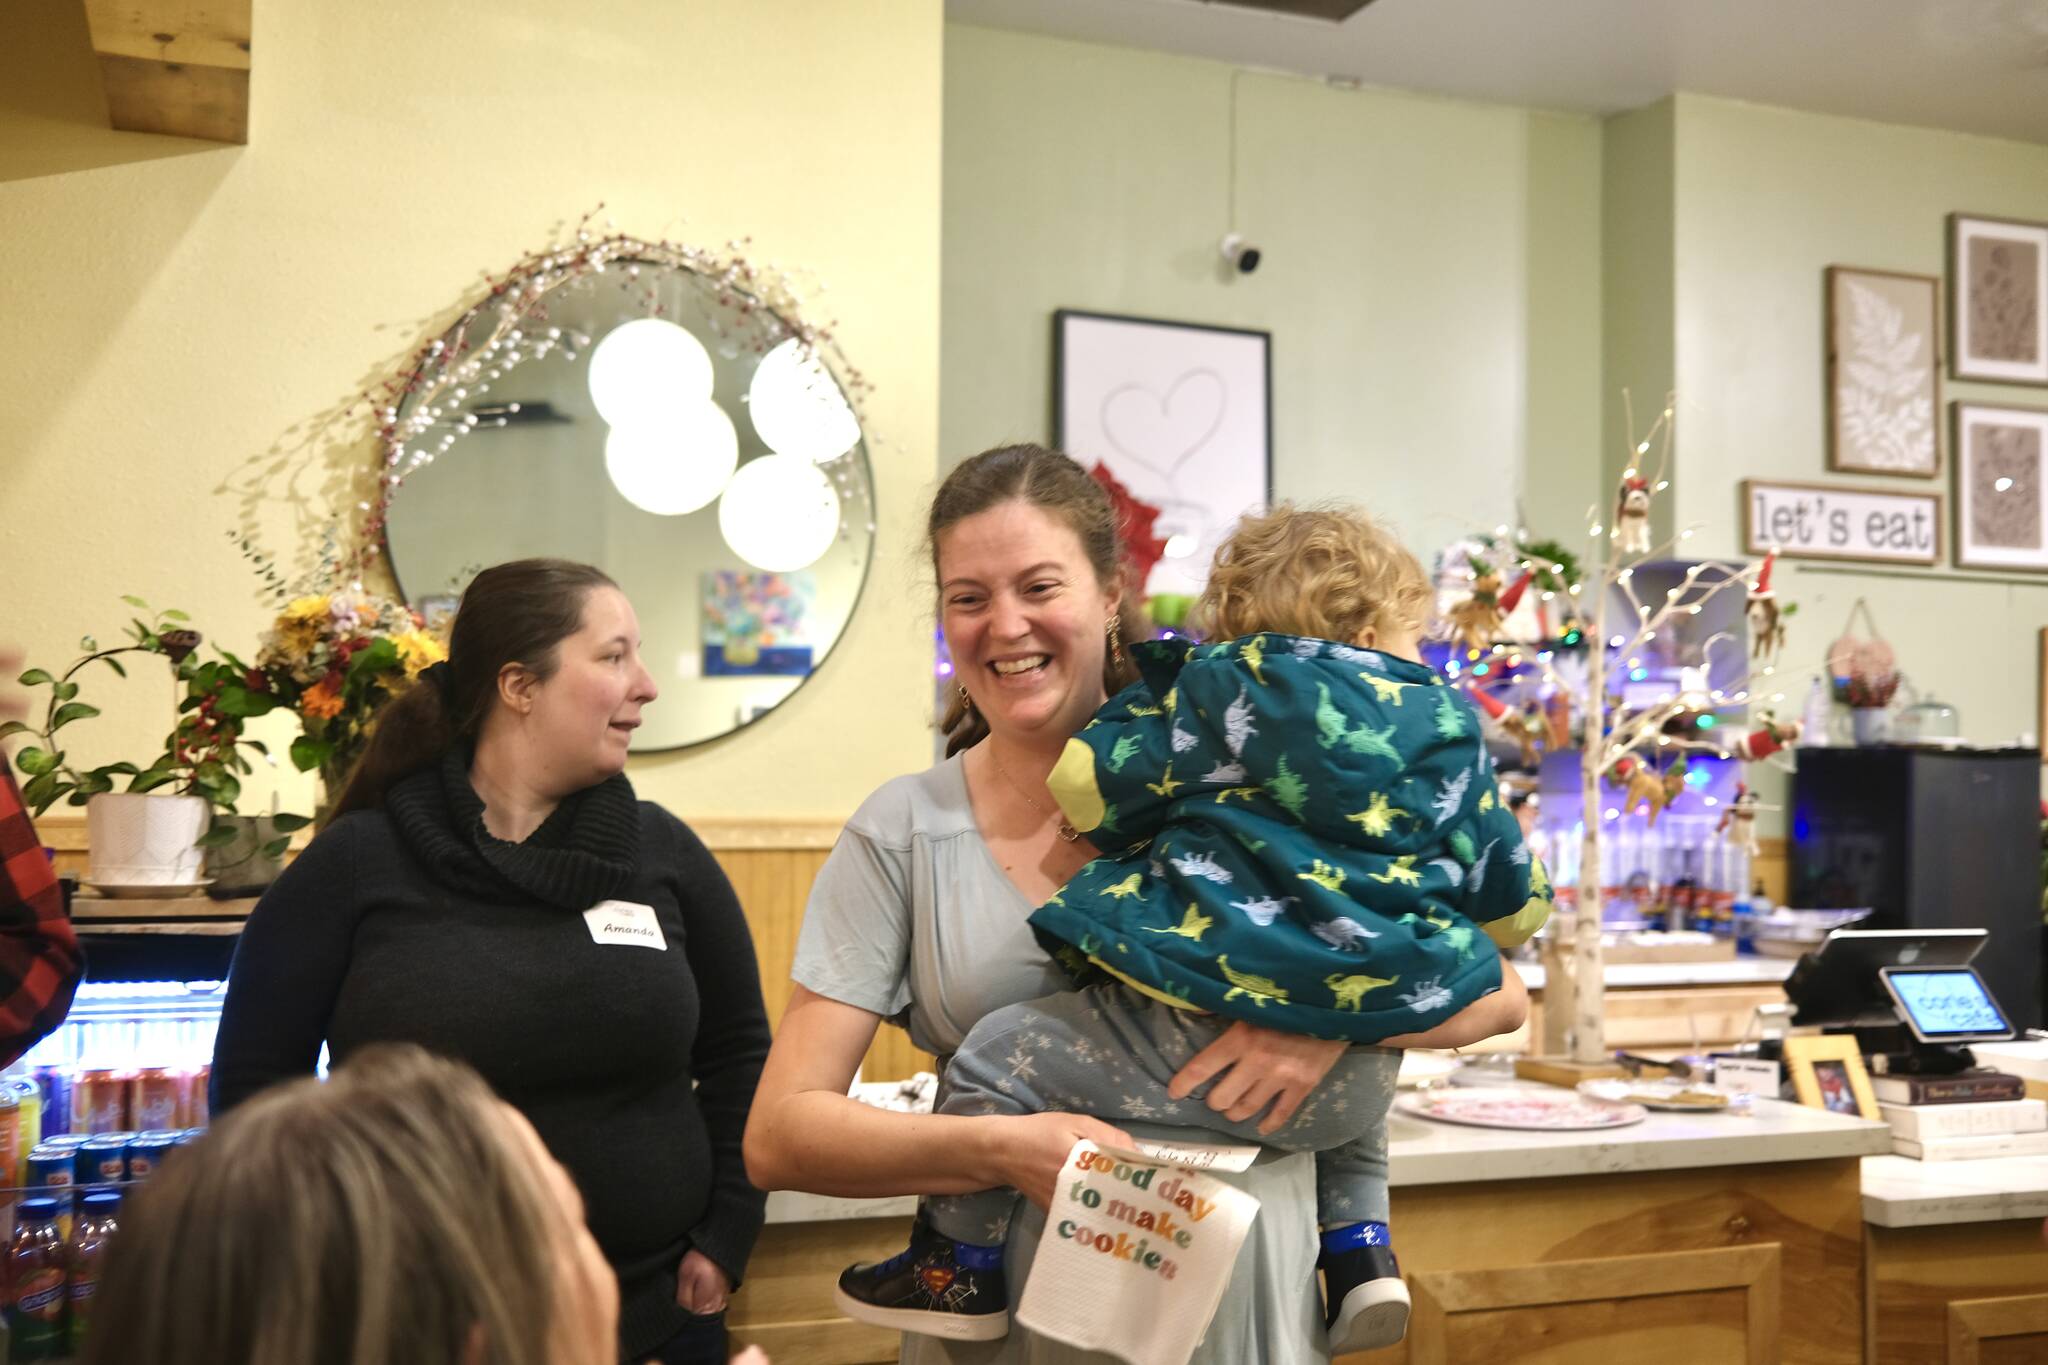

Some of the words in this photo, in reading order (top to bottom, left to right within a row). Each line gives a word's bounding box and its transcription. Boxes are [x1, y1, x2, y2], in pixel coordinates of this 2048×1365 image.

[1755, 493, 1850, 546] let's
[1866, 506, 1931, 551] eat
[604, 923, 655, 937] Amanda
[1070, 1179, 1101, 1209] to
[1106, 1198, 1193, 1249] make
[1074, 1150, 1157, 1191] good
[1157, 1177, 1216, 1223] day
[1057, 1218, 1180, 1281] cookies
